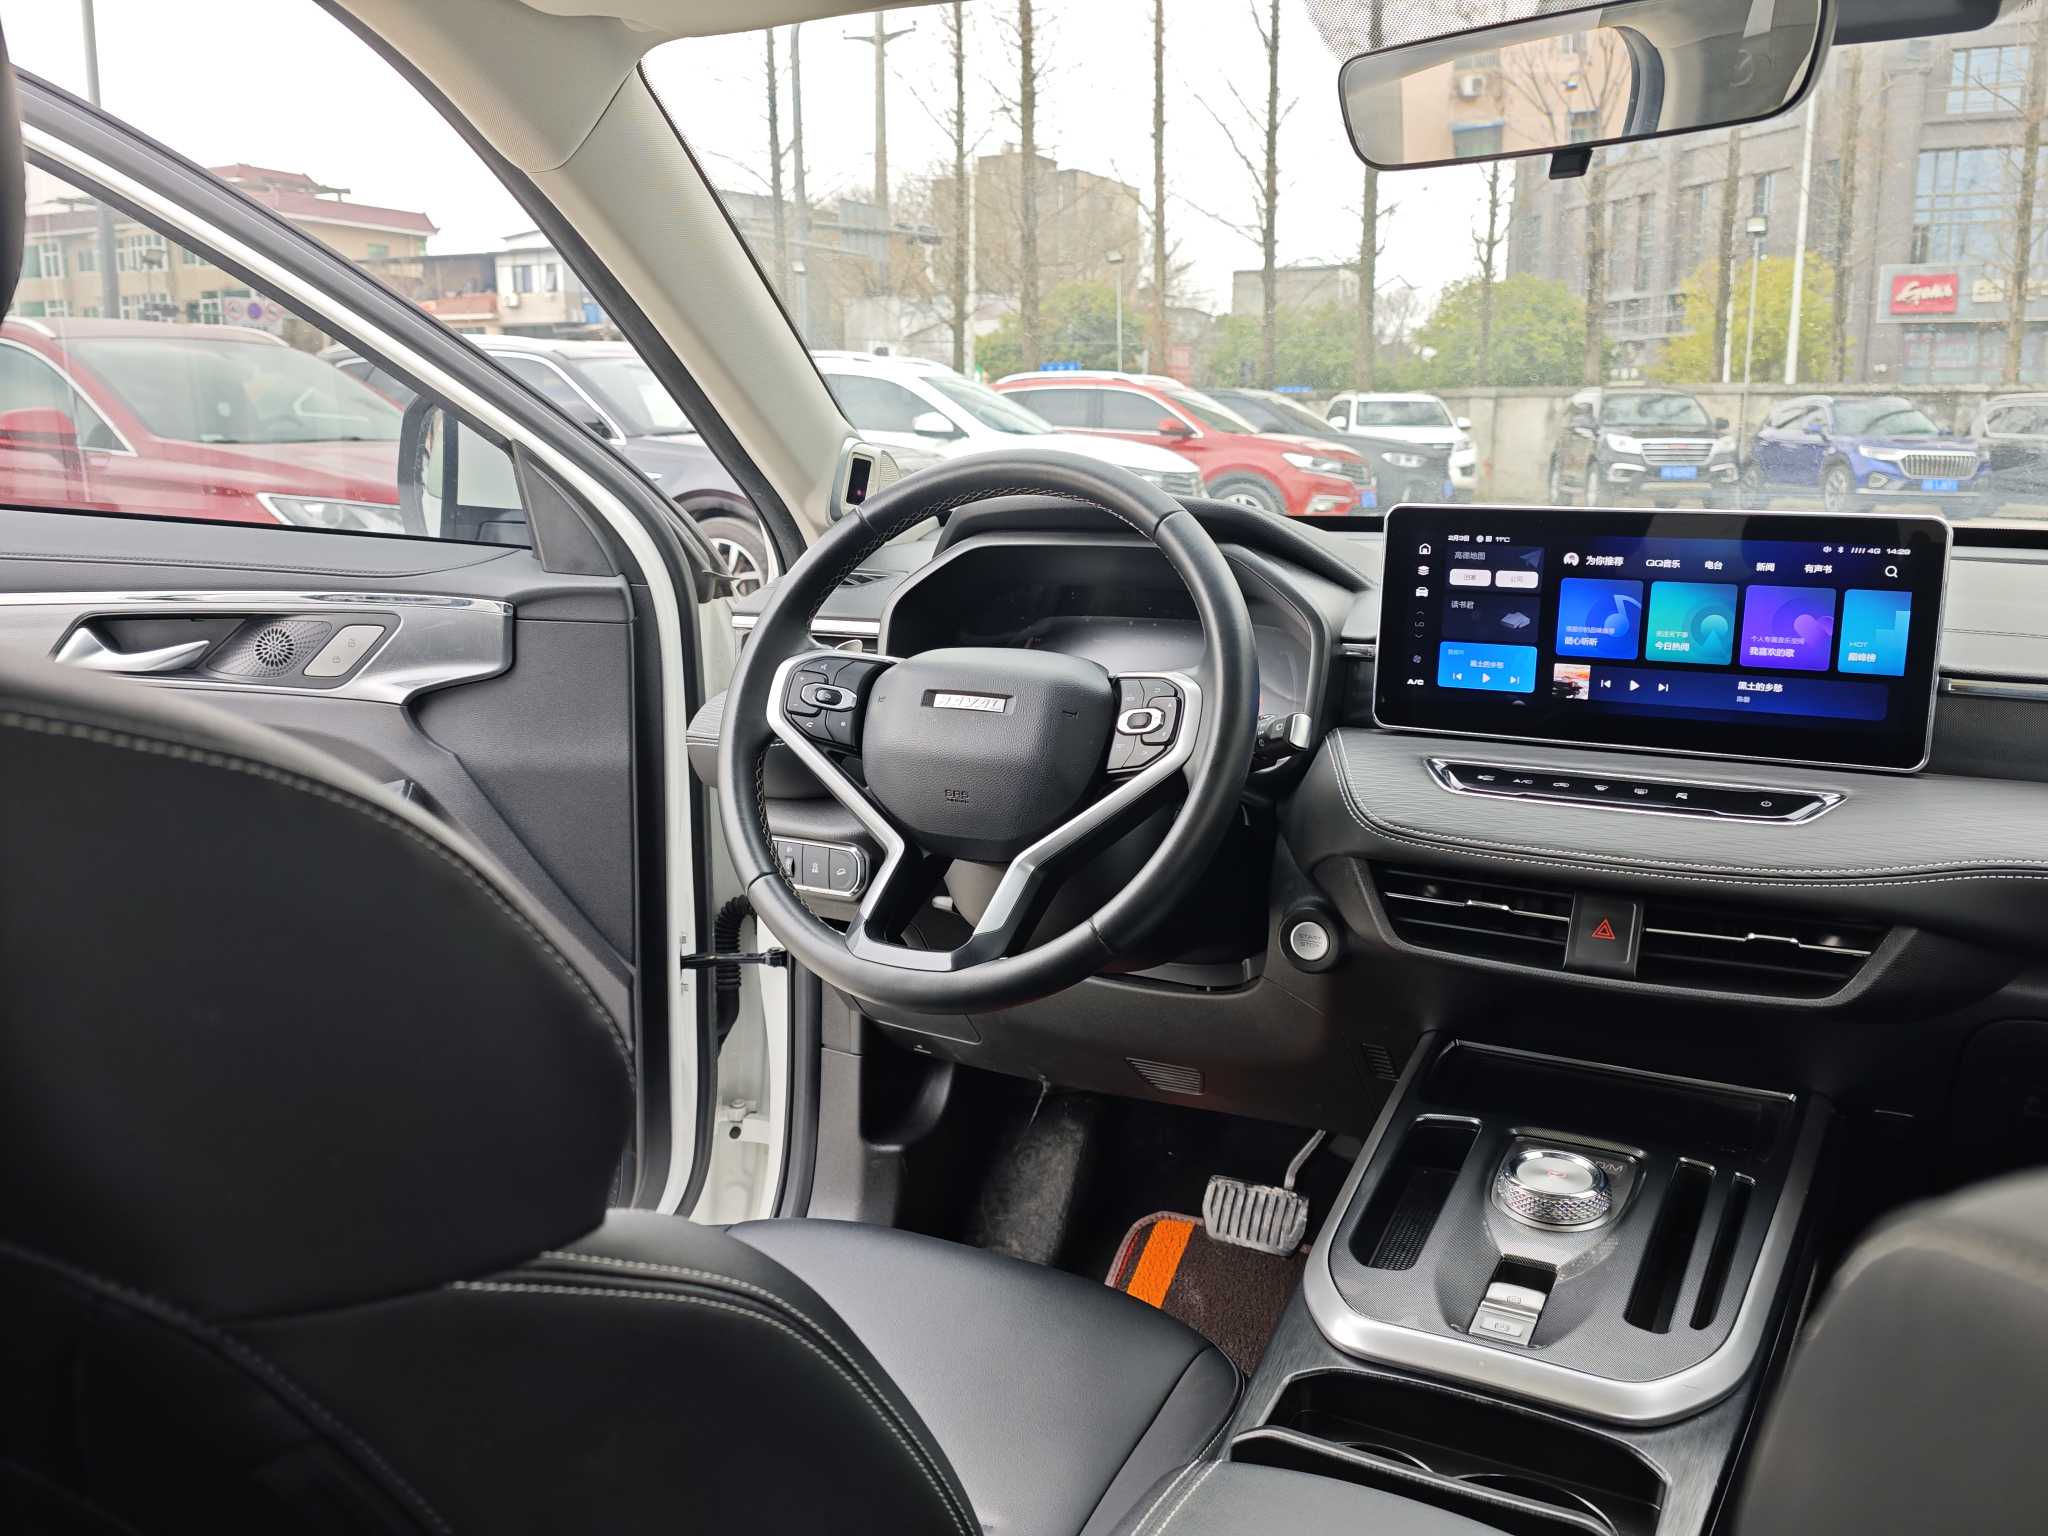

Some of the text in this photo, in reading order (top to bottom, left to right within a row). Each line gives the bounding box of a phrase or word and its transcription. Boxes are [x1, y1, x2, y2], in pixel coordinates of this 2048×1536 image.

[1454, 551, 1486, 560] 高德地图
[1585, 555, 1624, 567] 为你推荐
[1645, 559, 1681, 569] QQ音乐
[1704, 560, 1723, 570] 电台
[1756, 562, 1776, 572] 新闻
[1804, 564, 1833, 574] 有声书
[1749, 646, 1796, 658] 我喜欢的歌
[1407, 678, 1424, 686] A/C
